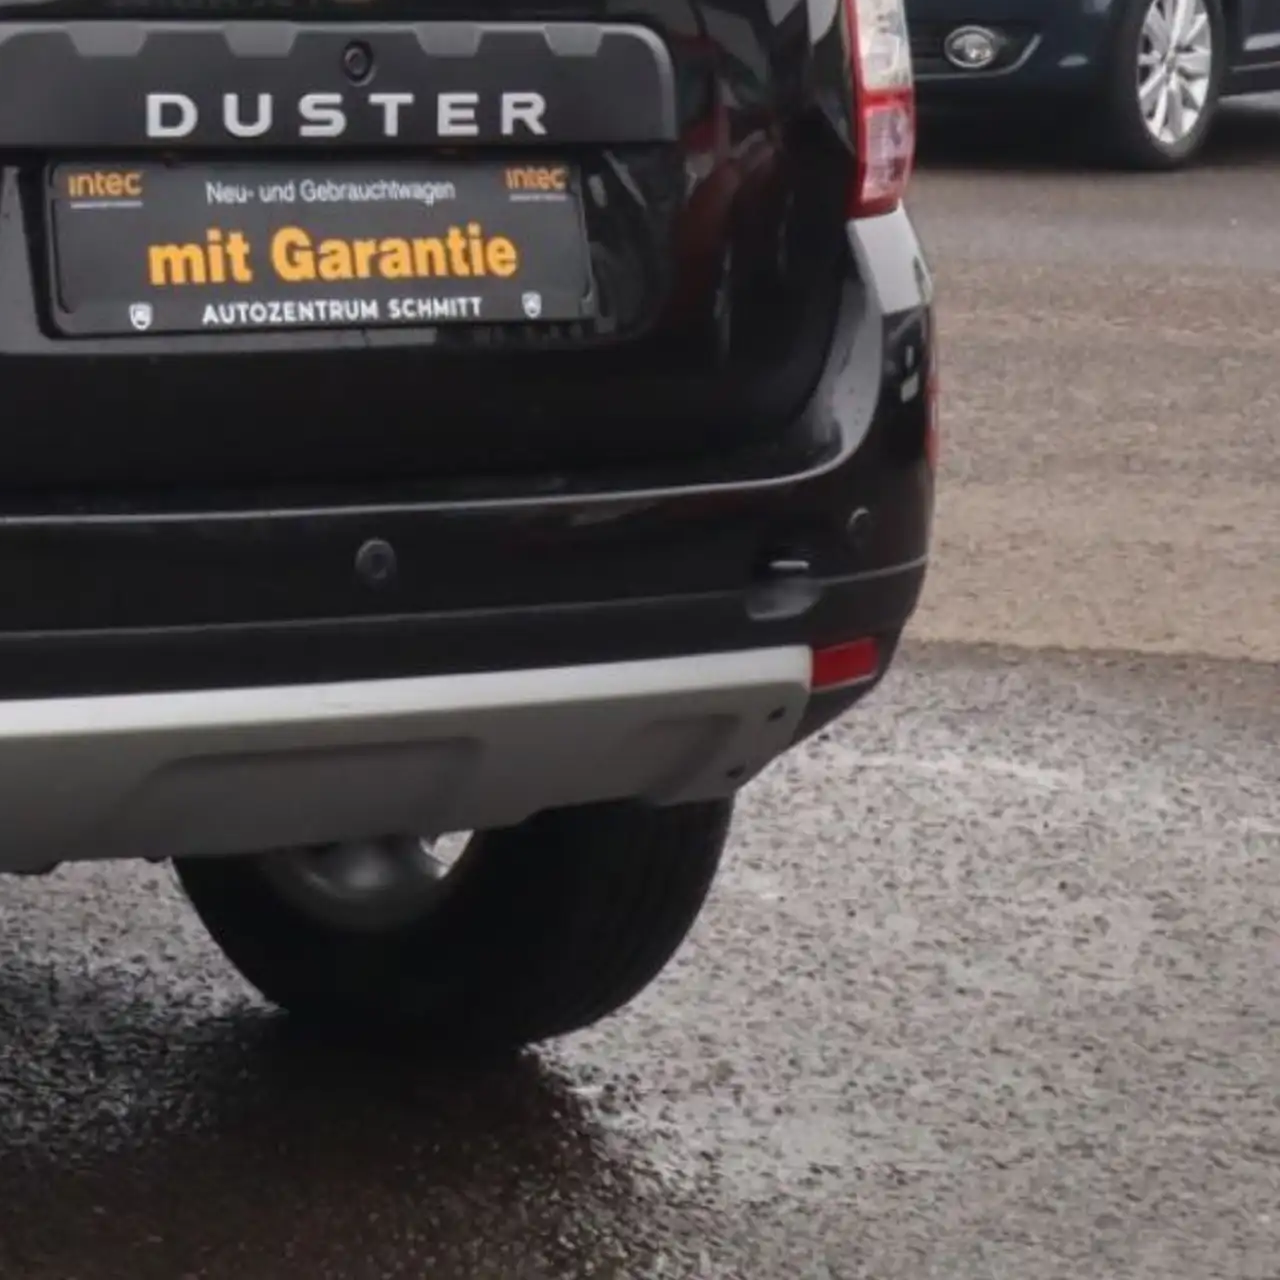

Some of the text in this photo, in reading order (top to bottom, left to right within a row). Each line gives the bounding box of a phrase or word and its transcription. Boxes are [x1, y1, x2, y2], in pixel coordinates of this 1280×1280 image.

[146, 92, 547, 138] DUSTER
[68, 171, 143, 198] intec
[505, 165, 566, 190] intec
[205, 178, 456, 207] Neu- und Gebrauchtwagen
[148, 221, 518, 286] mit Garantie
[202, 296, 483, 325] AUTOZENTRUM SCHMITT
